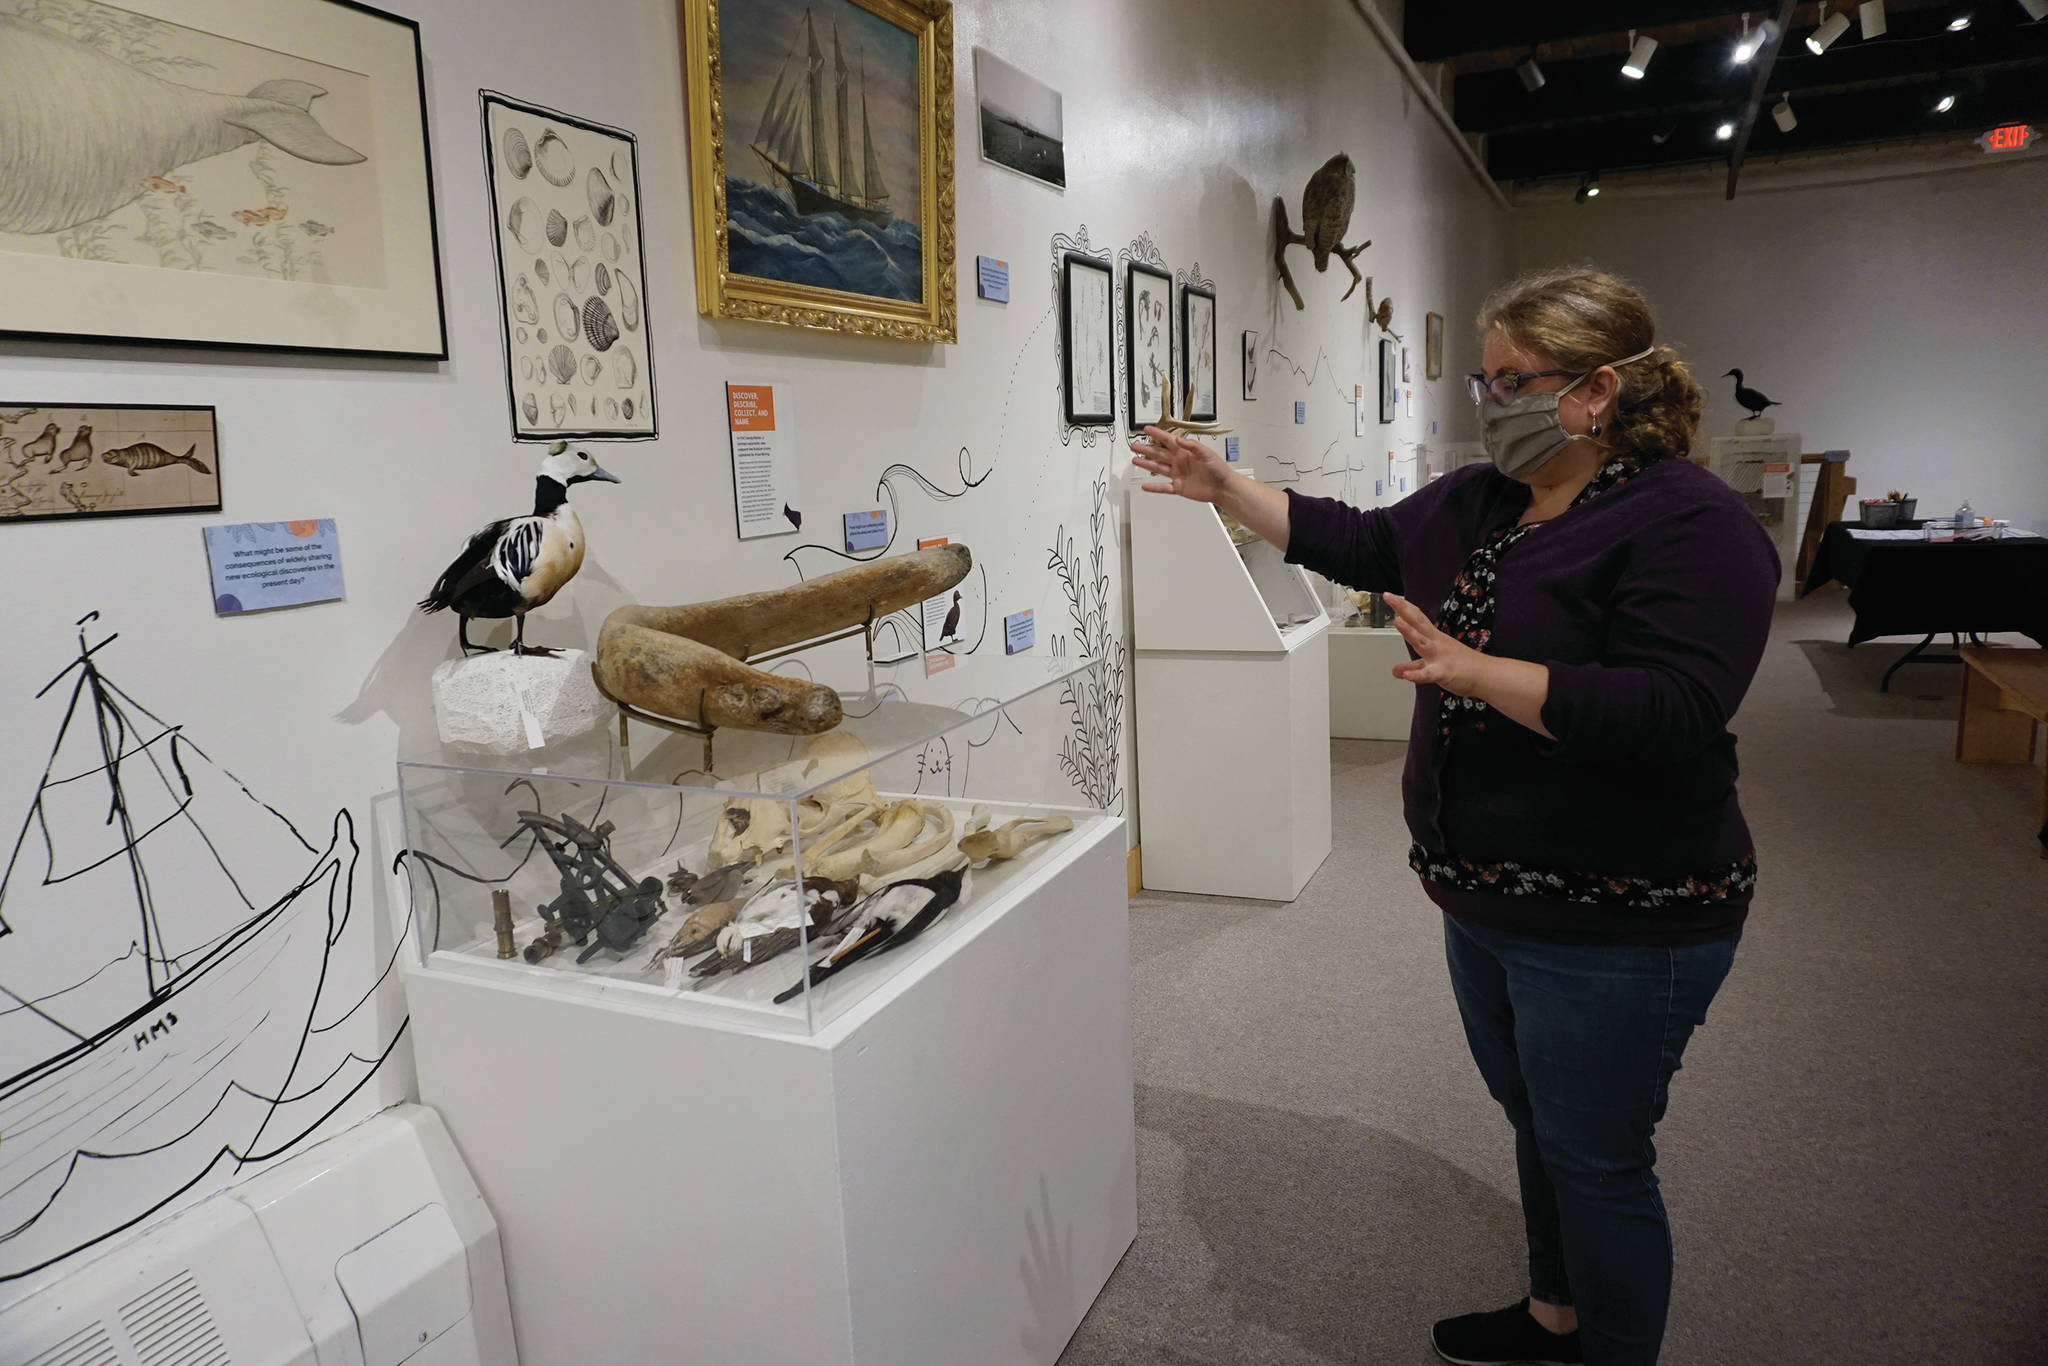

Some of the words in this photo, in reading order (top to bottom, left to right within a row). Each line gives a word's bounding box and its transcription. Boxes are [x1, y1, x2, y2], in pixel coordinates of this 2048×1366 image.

[1992, 125, 2027, 150] EXIT
[732, 391, 759, 400] DISCOVER,
[735, 417, 750, 425] NAME
[233, 550, 253, 558] What
[254, 548, 274, 557] might
[225, 559, 277, 570] consequences
[286, 555, 307, 563] widely
[308, 553, 333, 561] sharing
[242, 569, 278, 579] ecological
[278, 565, 317, 575] discoveries
[261, 579, 288, 589] present
[289, 577, 305, 585] day?
[133, 1012, 178, 1051] HMS
